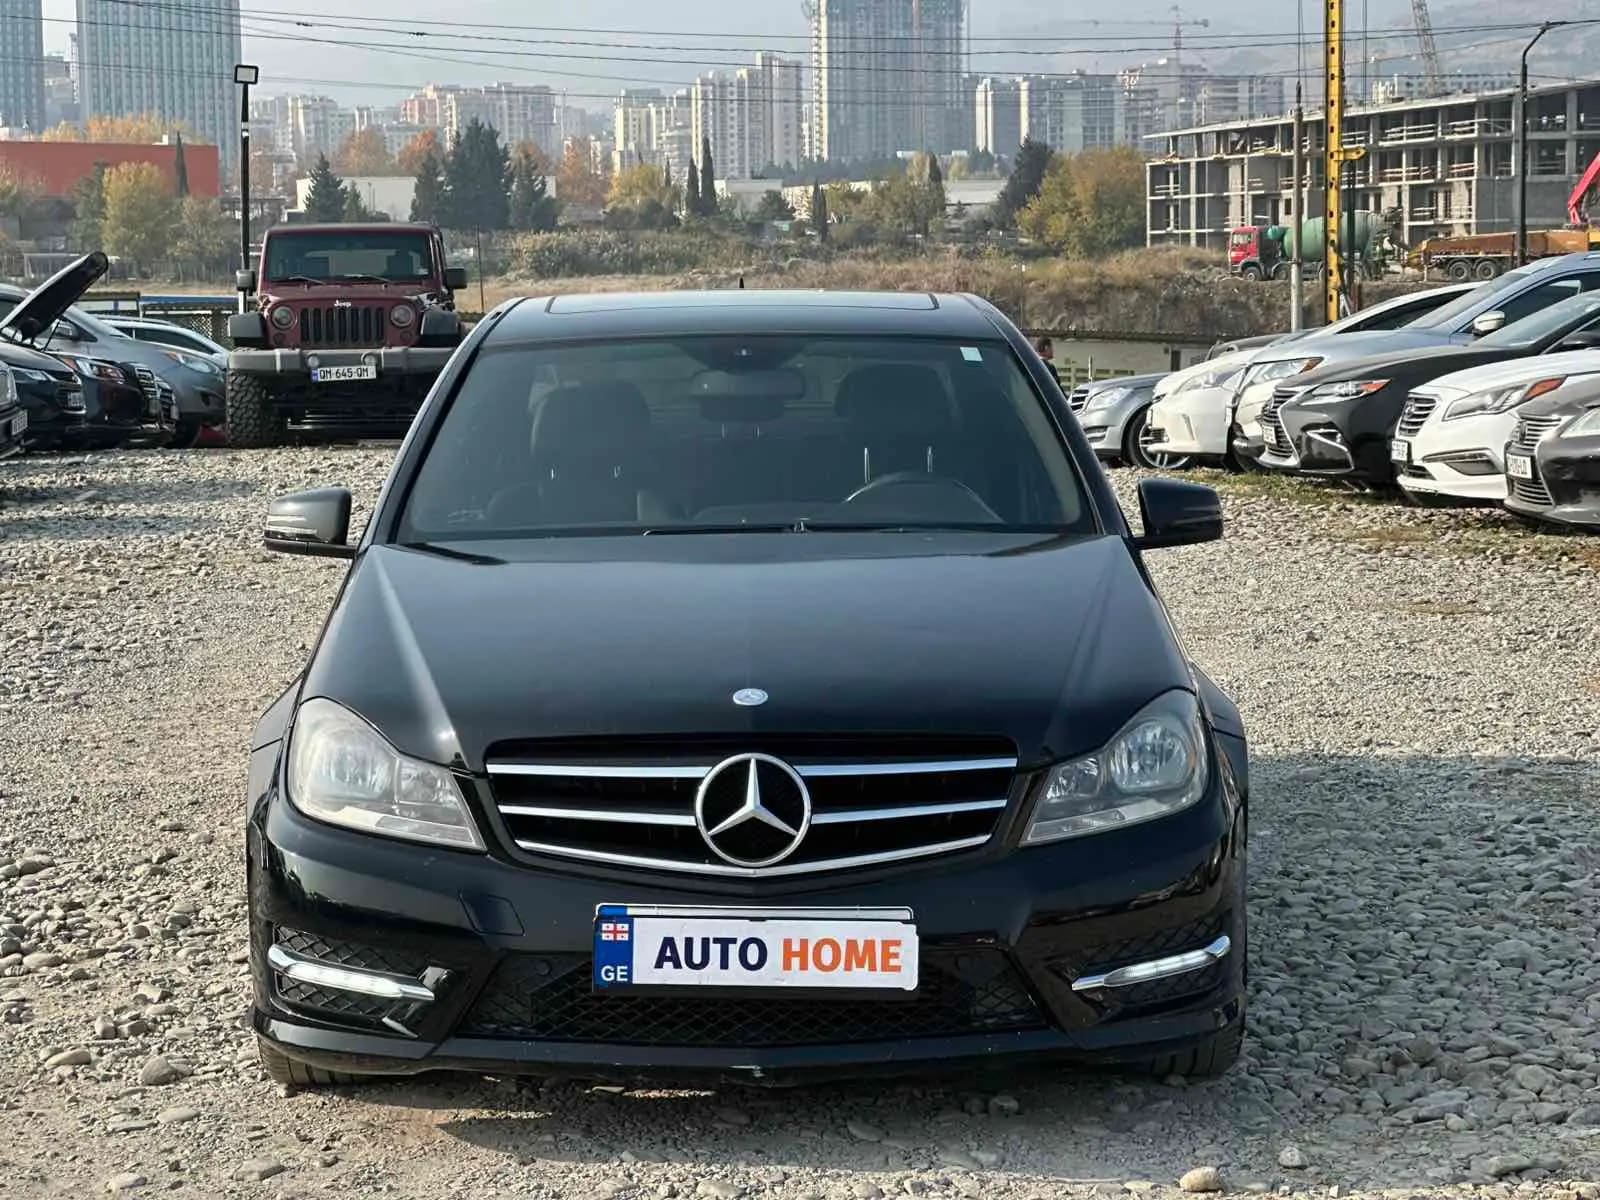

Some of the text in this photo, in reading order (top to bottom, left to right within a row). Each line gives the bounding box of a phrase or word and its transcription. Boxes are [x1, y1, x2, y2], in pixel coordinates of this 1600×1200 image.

[653, 936, 902, 973] AUTO HOME
[600, 964, 629, 982] GE
